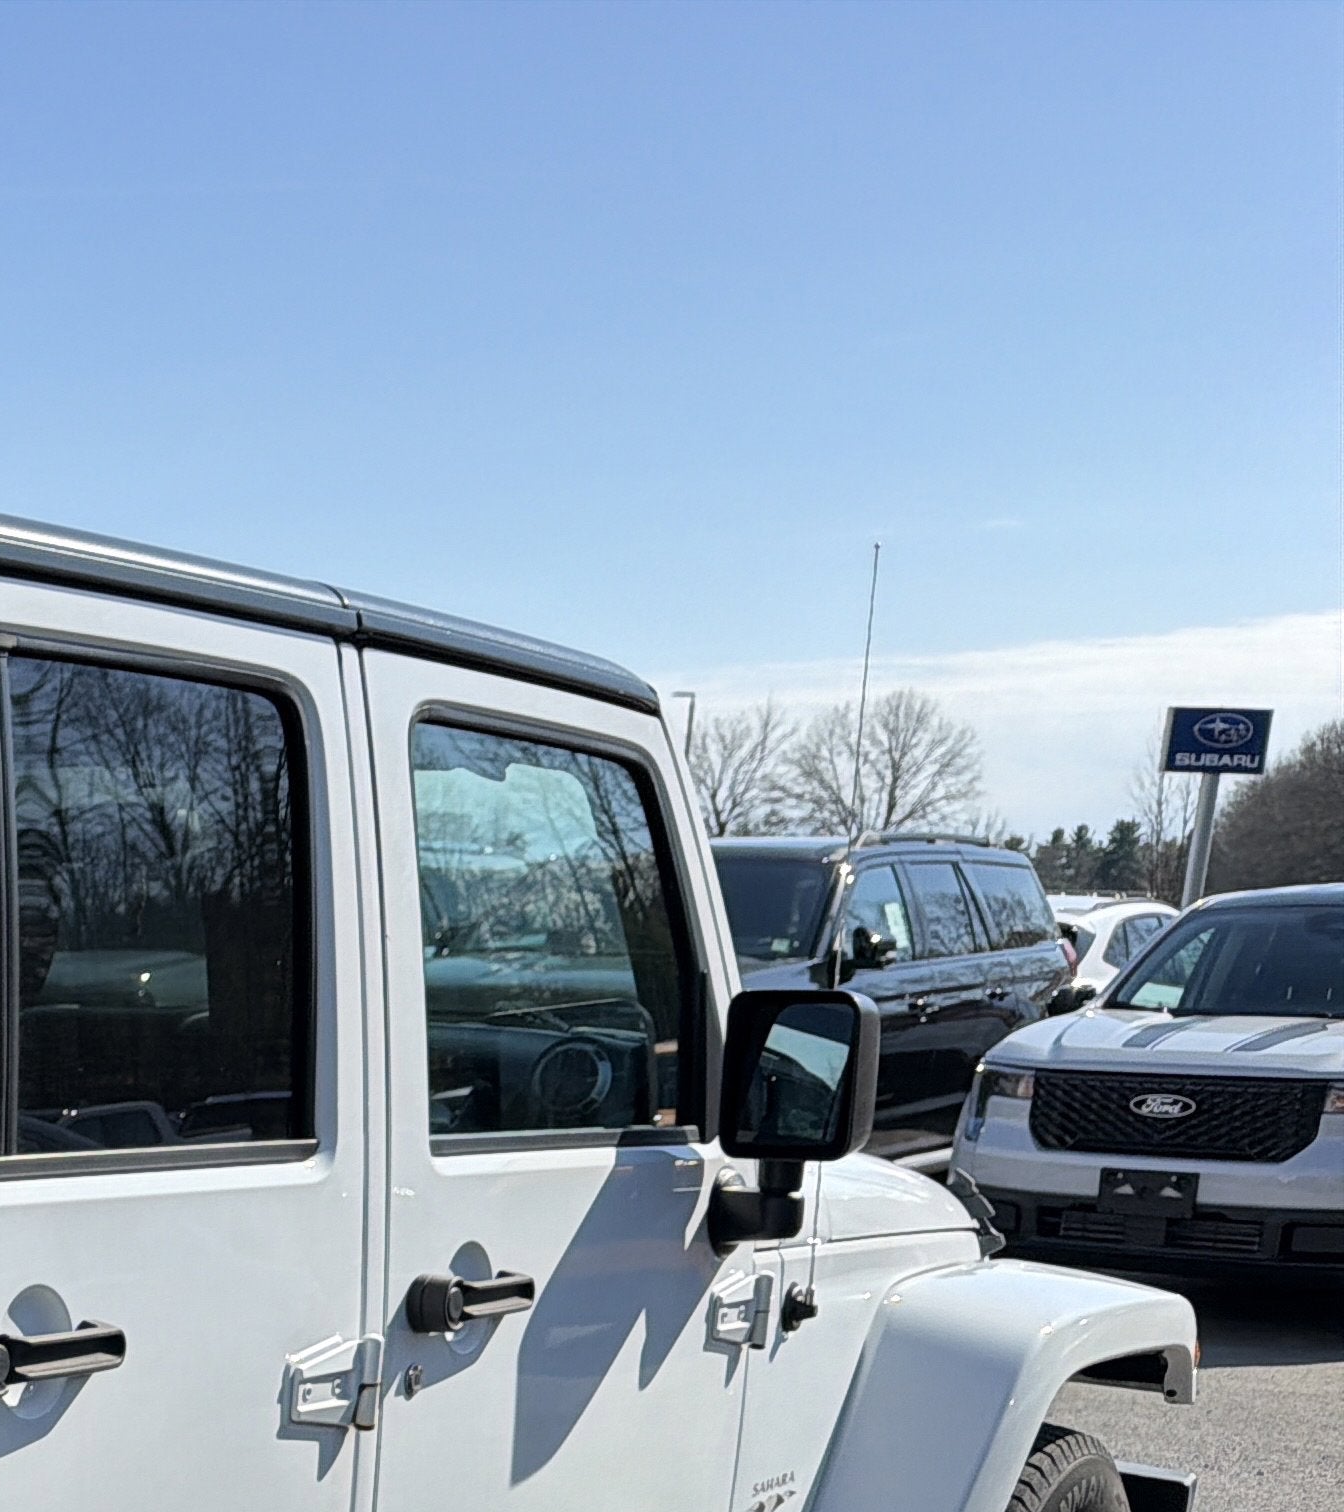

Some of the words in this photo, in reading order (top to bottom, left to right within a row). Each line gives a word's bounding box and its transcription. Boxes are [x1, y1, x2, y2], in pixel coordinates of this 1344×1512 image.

[1175, 752, 1260, 768] SUBARU
[1141, 1096, 1184, 1115] Ford
[751, 1470, 796, 1498] SAHARA
